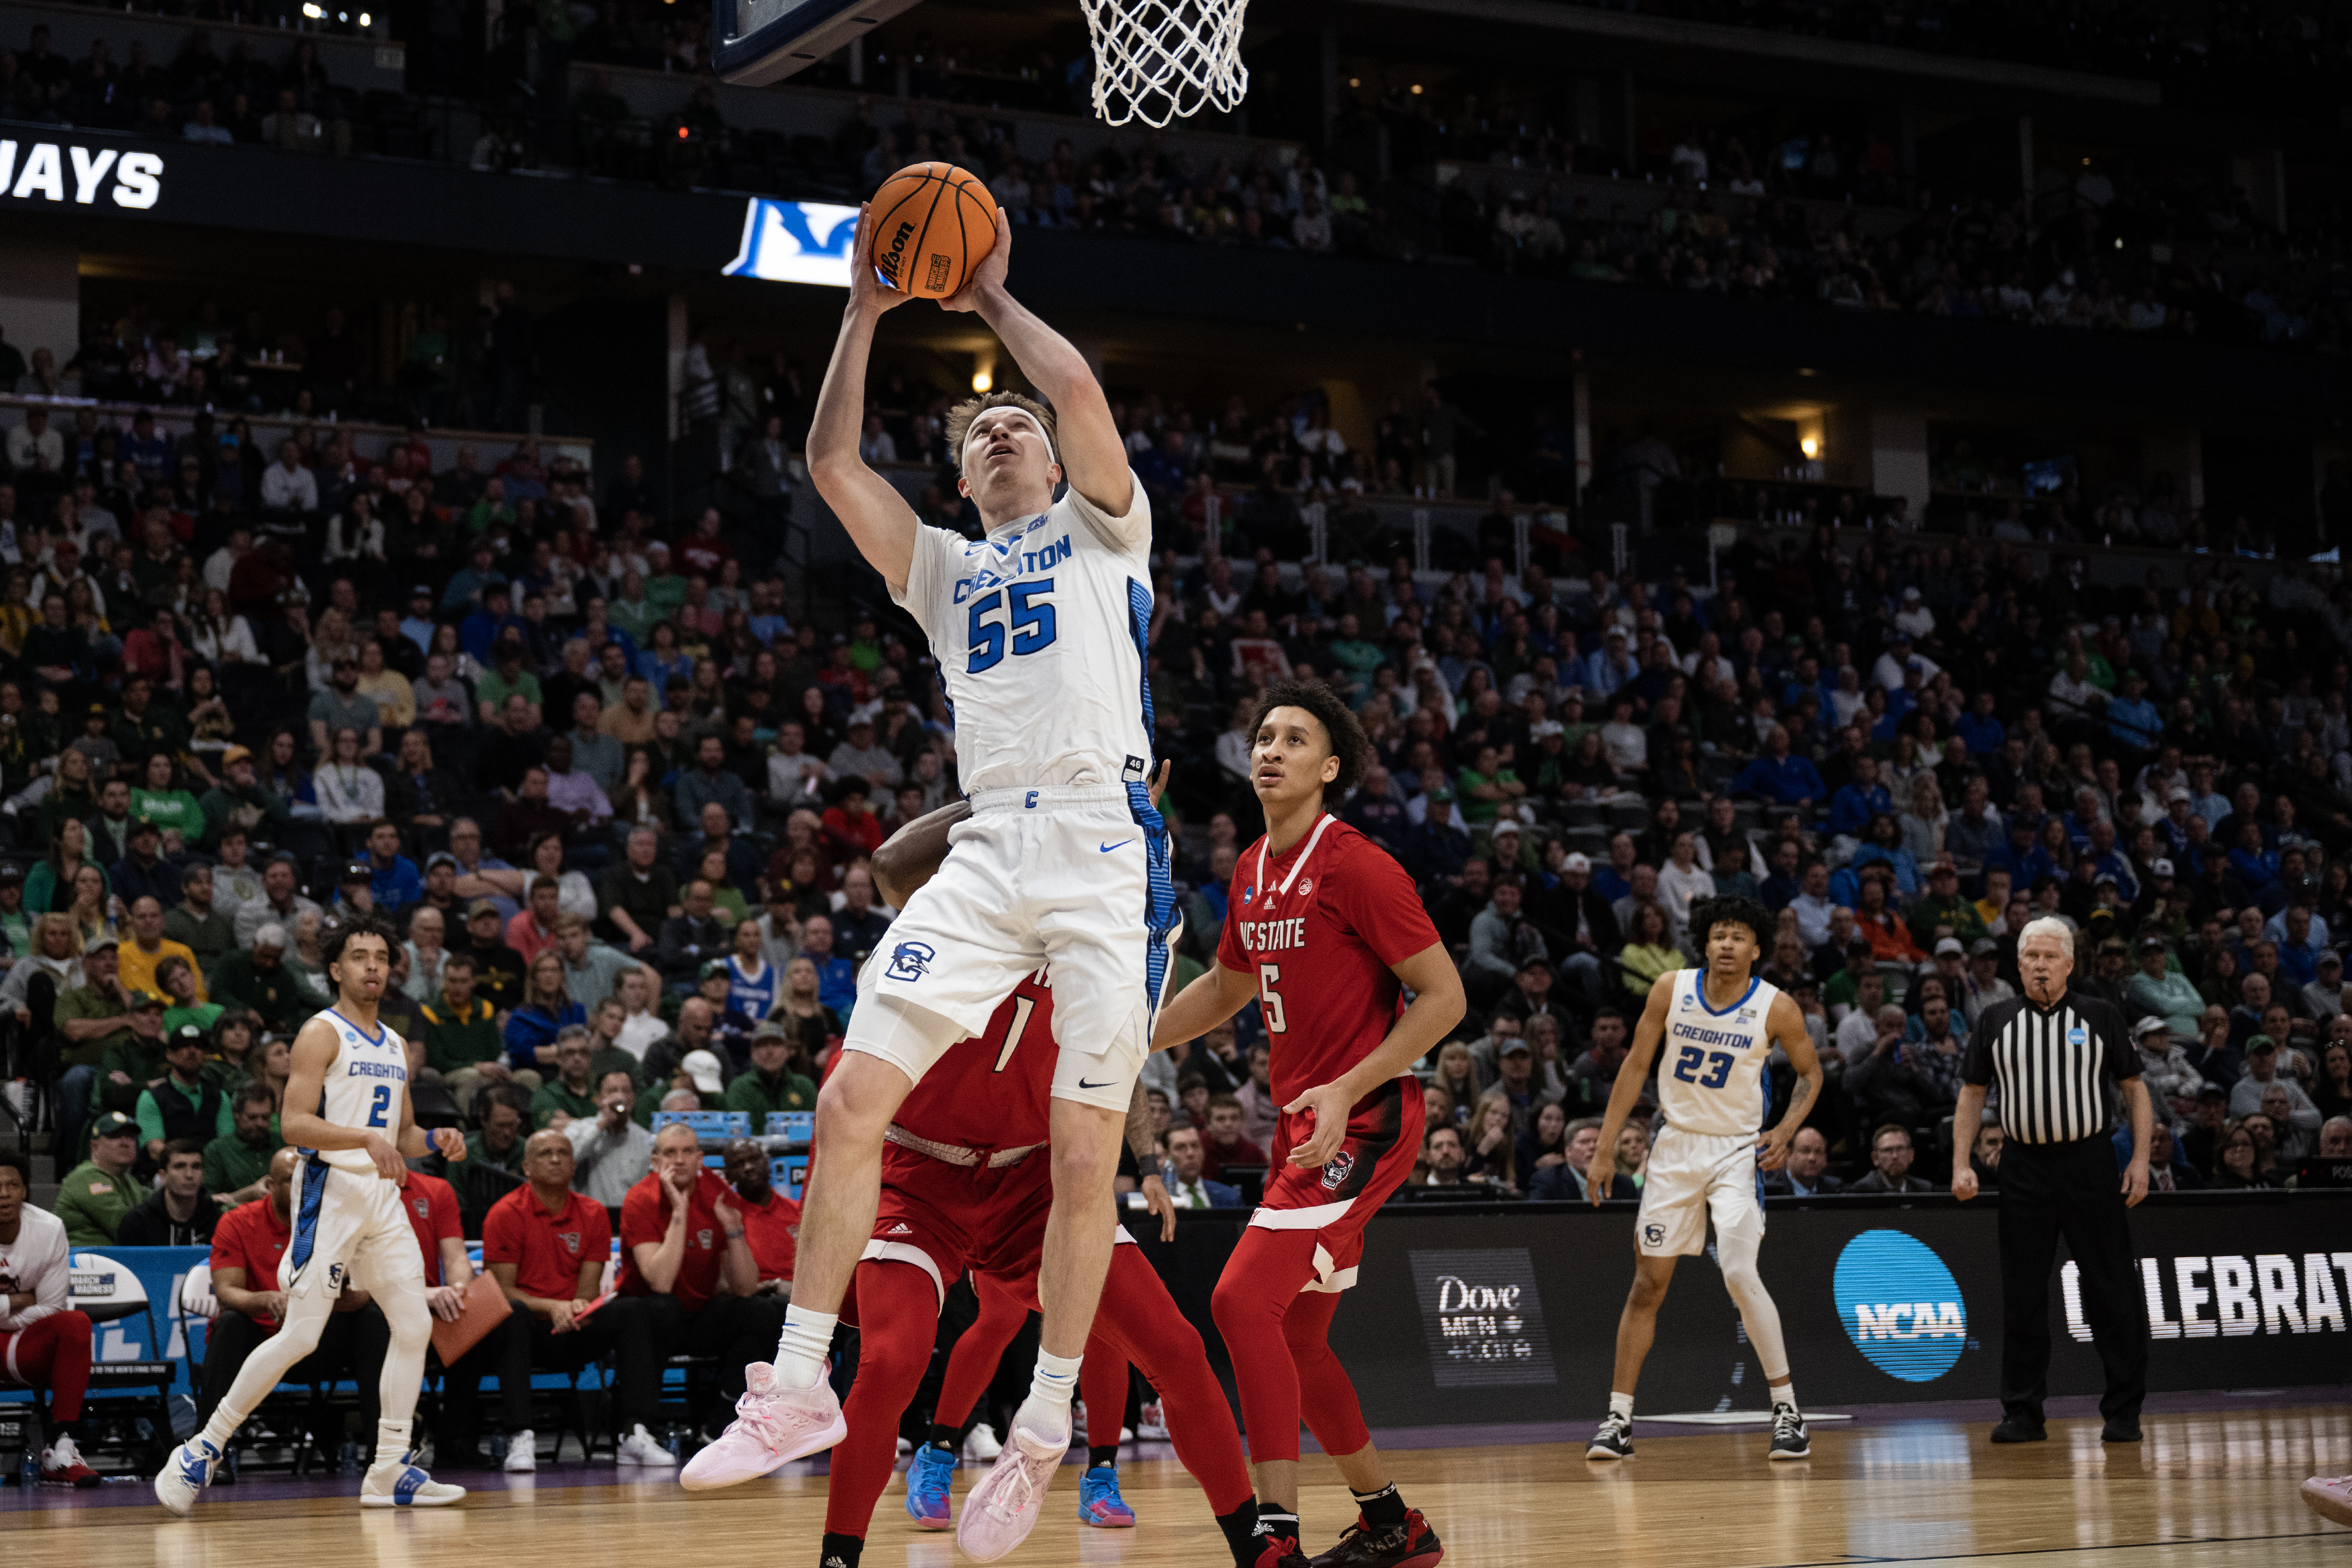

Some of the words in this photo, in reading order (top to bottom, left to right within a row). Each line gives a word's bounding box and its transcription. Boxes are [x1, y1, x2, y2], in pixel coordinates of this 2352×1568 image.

[927, 265, 939, 286] MARCH
[935, 255, 949, 284] MADNESS
[965, 577, 1057, 674] 55
[1130, 759, 1141, 769] 46
[1240, 921, 1256, 951] NC
[1257, 916, 1306, 951] STATE
[1260, 962, 1288, 1035] 5
[991, 992, 1037, 1074] 1
[1673, 1022, 1753, 1050] CREIGHTON
[1673, 1045, 1735, 1089] 23
[367, 1084, 391, 1128] 2
[1436, 1276, 1520, 1313] Dove
[1855, 1302, 1967, 1341] NCAA
[825, 1560, 847, 1568] adidas
